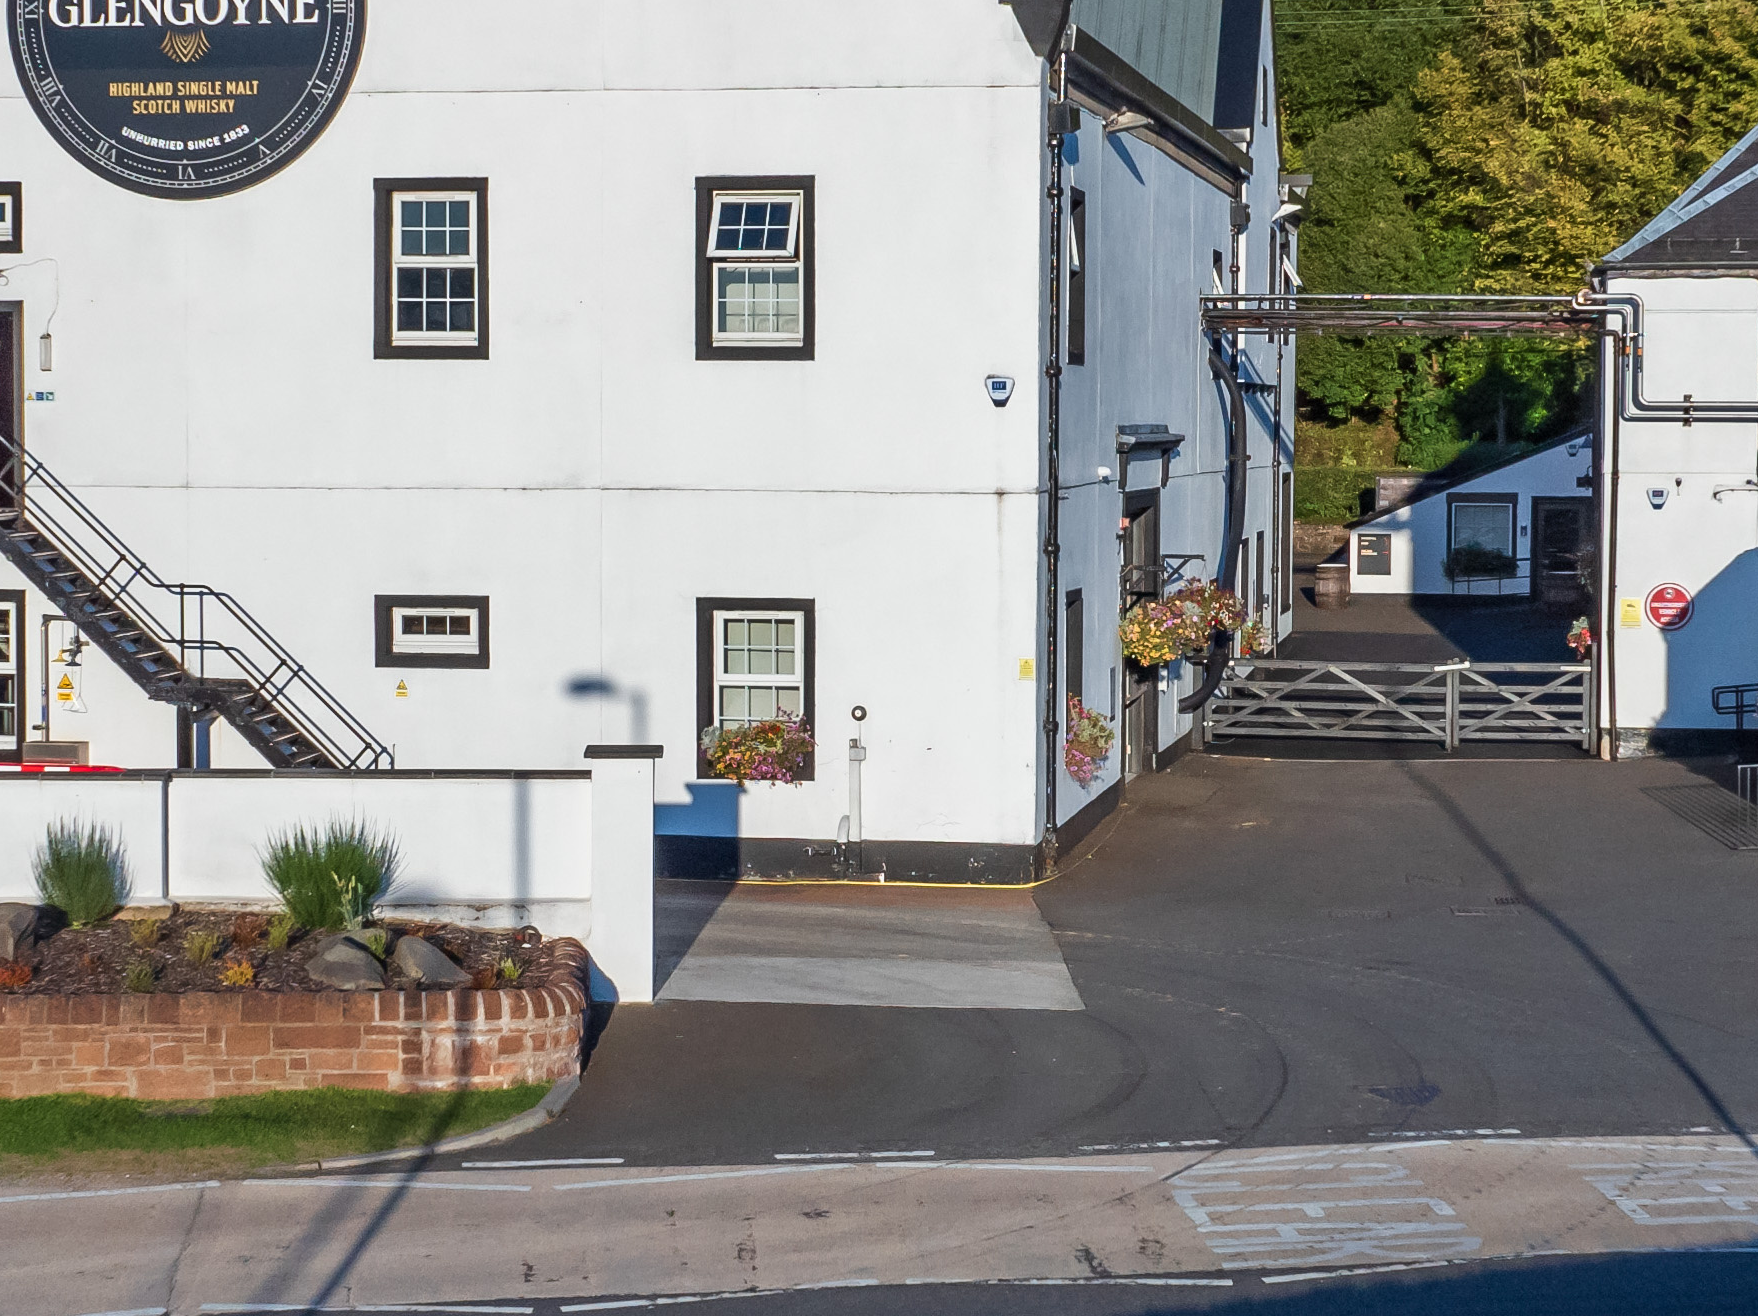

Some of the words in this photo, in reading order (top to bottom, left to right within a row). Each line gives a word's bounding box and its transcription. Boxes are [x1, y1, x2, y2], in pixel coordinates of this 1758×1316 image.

[24, 0, 39, 20] IX
[39, 76, 62, 109] VIII
[108, 82, 174, 97] HIGHLAND
[176, 81, 222, 96] SINGLE
[226, 80, 260, 95] MALT
[132, 99, 181, 115] SCOTCH
[184, 99, 236, 114] WHISKY
[121, 126, 185, 152] UNHURRIED
[187, 137, 222, 151] SINCE
[223, 124, 251, 144] 1833
[95, 139, 118, 163] VII
[257, 144, 272, 159] V
[178, 165, 196, 180] VI
